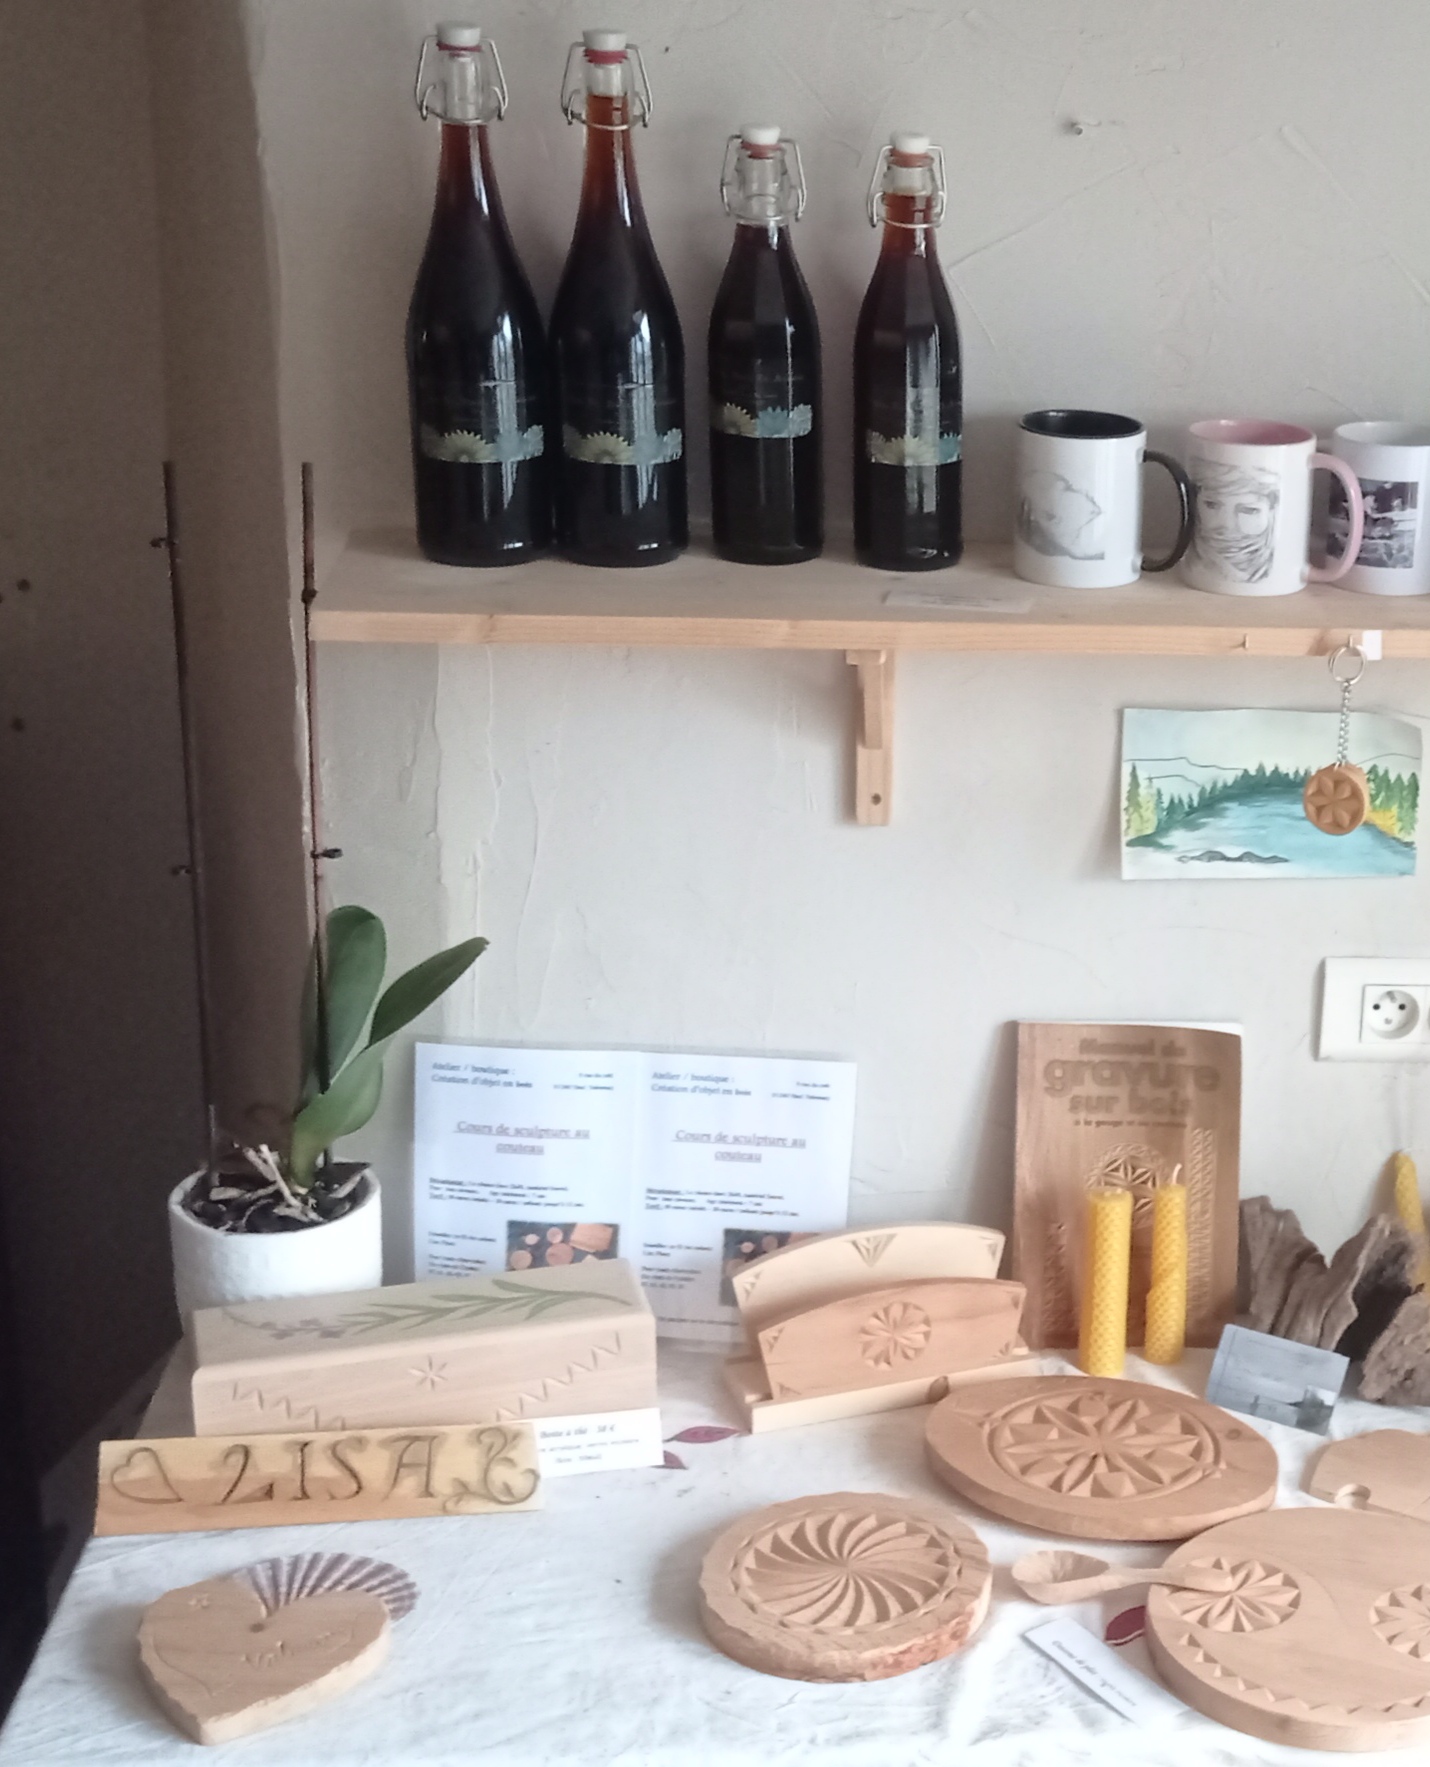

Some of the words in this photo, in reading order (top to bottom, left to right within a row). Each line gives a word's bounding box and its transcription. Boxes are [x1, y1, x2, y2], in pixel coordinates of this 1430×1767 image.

[1043, 1058, 1221, 1098] gravure
[456, 1120, 493, 1134] Cours
[495, 1123, 510, 1137] de
[675, 1129, 711, 1143] Cours
[714, 1131, 729, 1145] de
